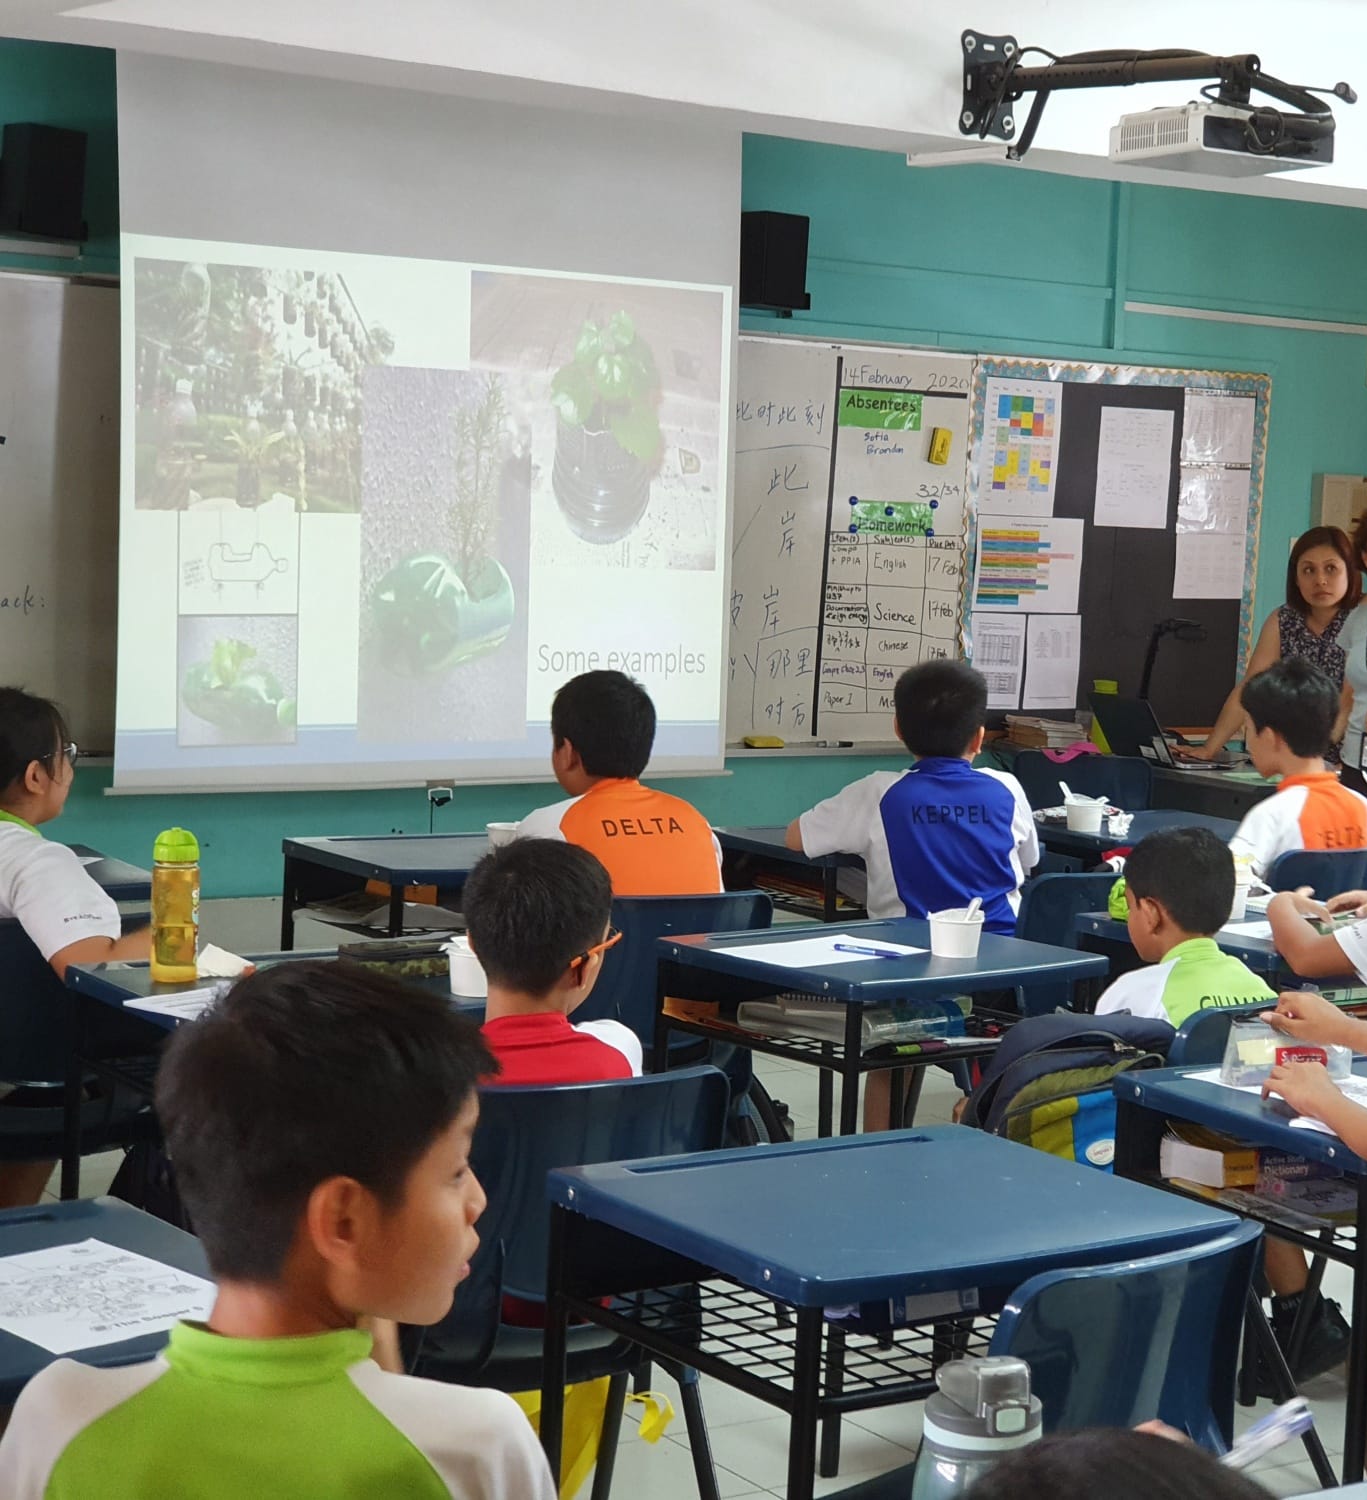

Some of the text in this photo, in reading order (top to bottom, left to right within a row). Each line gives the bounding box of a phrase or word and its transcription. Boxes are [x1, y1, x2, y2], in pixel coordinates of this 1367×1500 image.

[843, 365, 969, 391] 14 February 2020
[846, 394, 917, 413] Absentees
[864, 432, 889, 442] Sofia
[767, 464, 809, 495] 此
[916, 483, 960, 498] 32/34
[874, 551, 907, 573] English
[873, 602, 917, 626] Science
[537, 644, 600, 673] Some
[607, 643, 706, 680] examples
[911, 804, 991, 825] KEPPEL
[601, 817, 684, 838] DELTA
[1264, 1165, 1309, 1177] Dictionary
